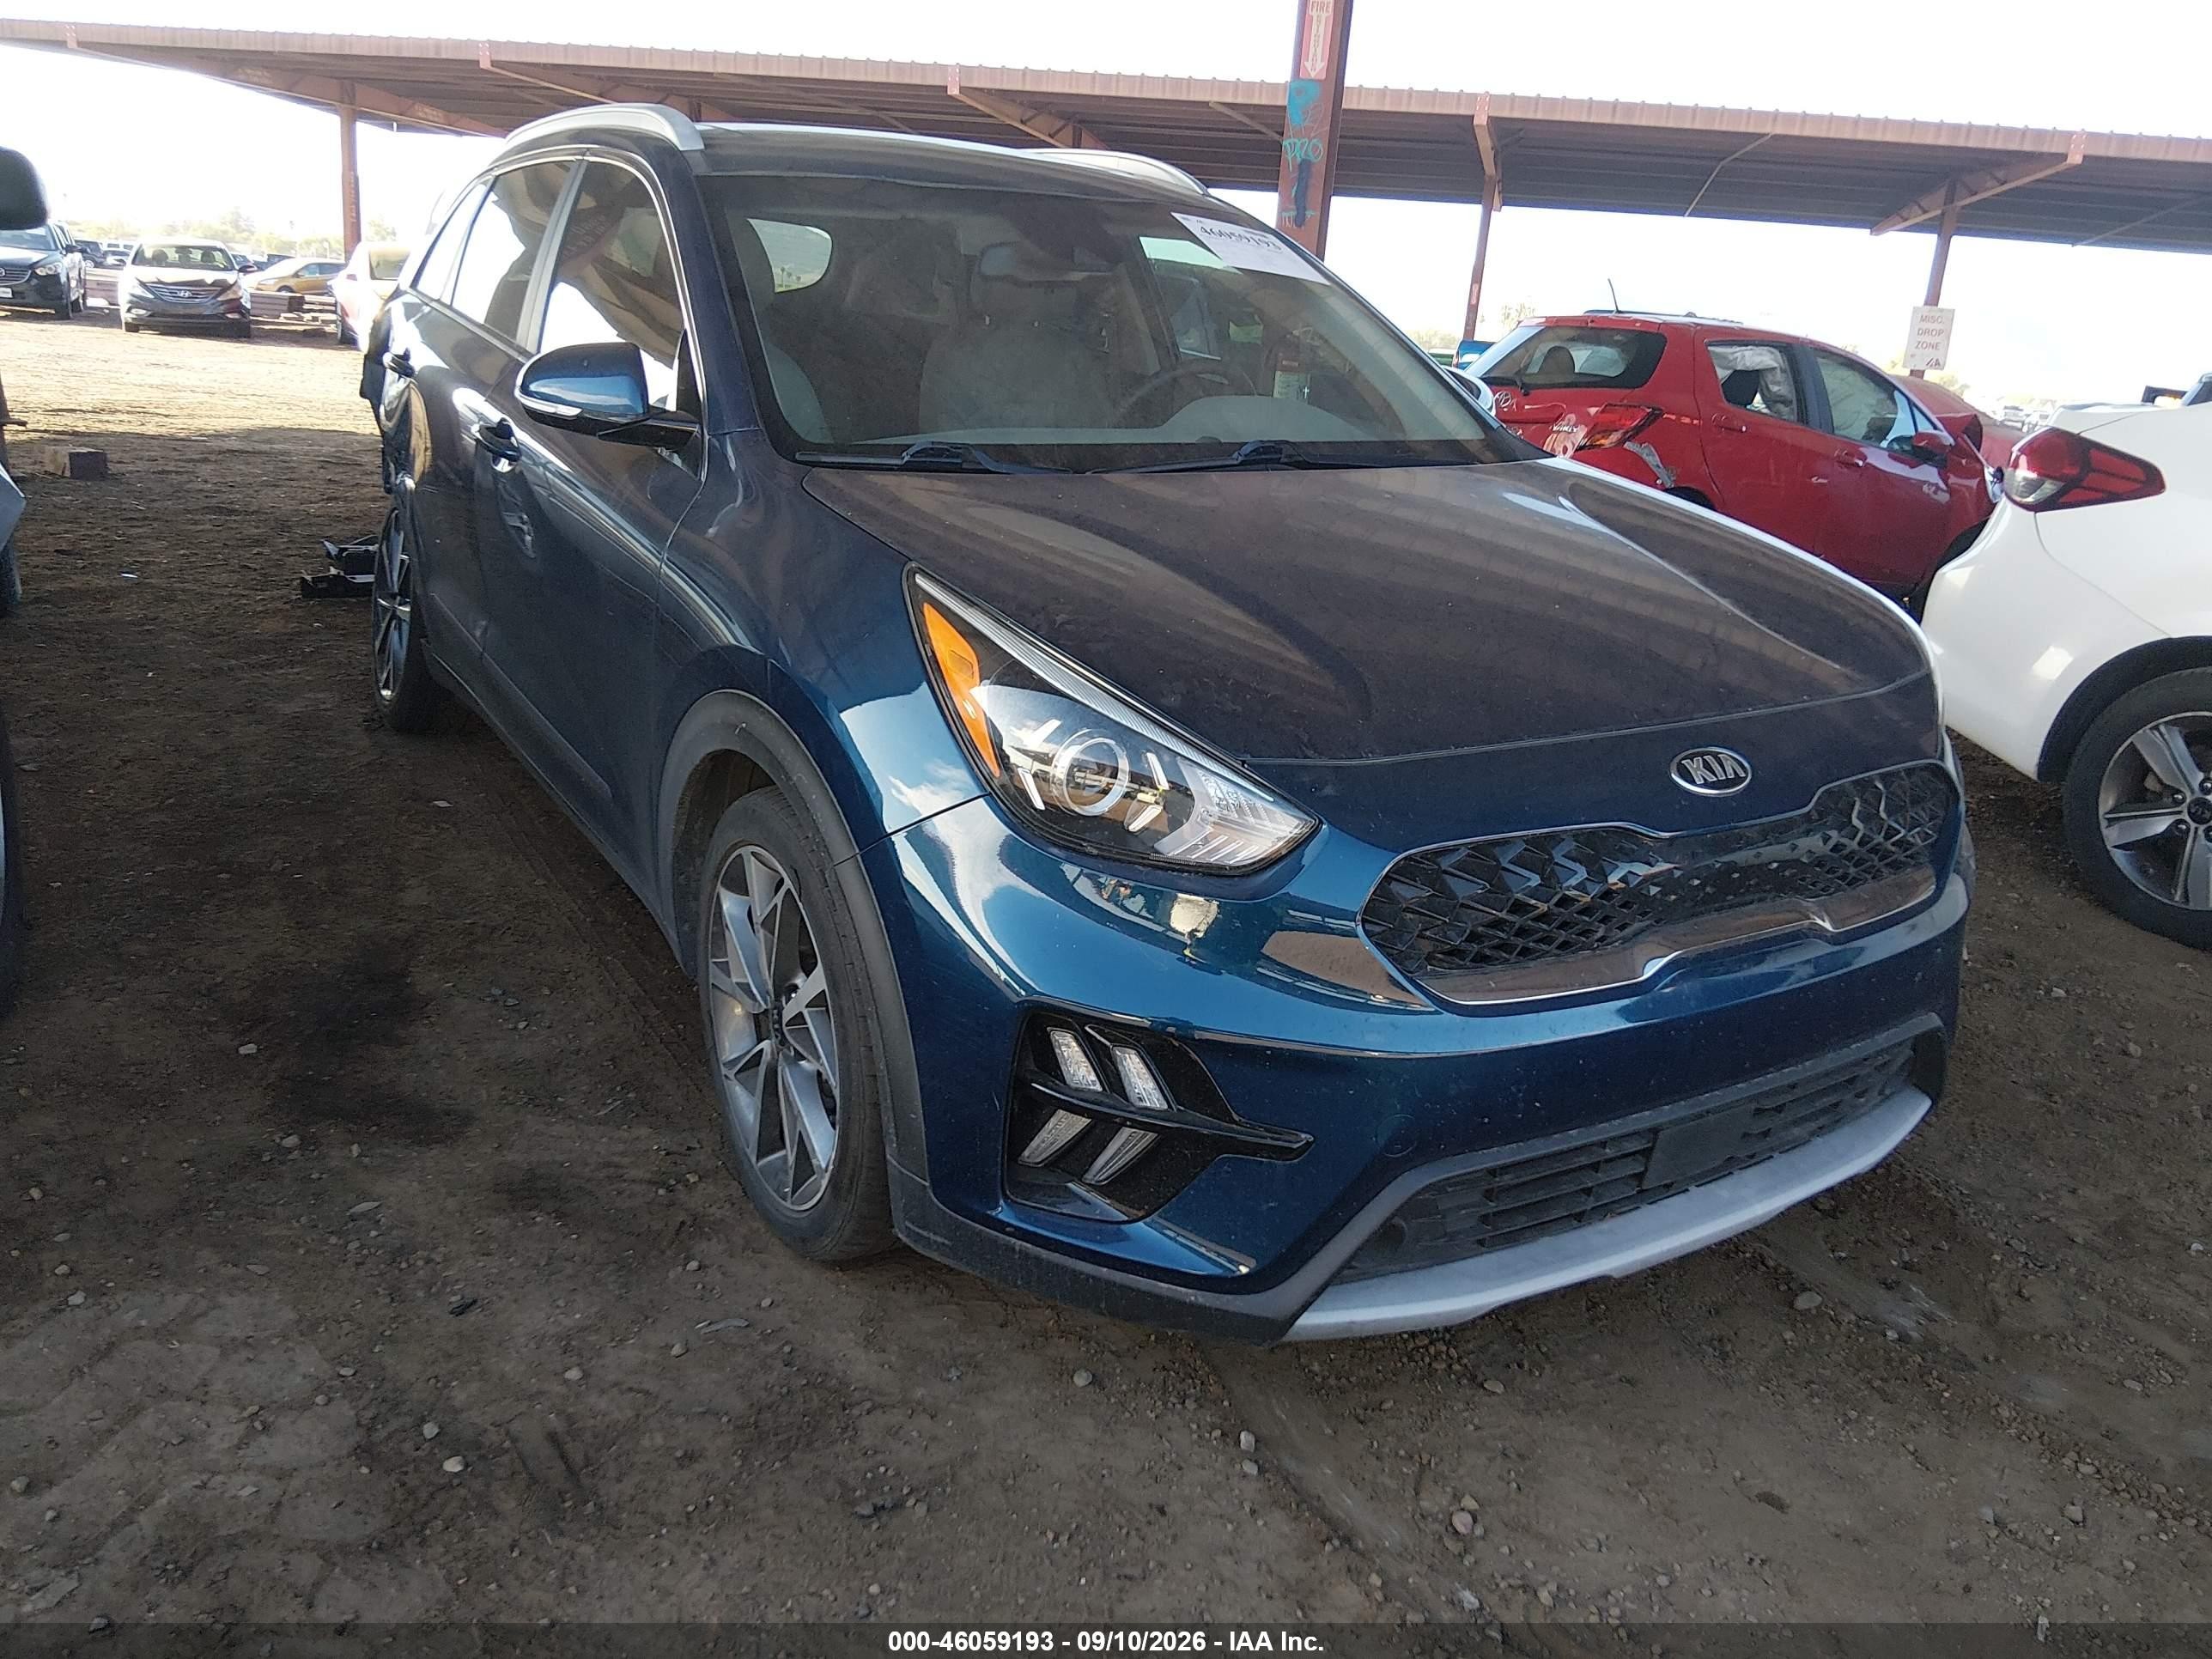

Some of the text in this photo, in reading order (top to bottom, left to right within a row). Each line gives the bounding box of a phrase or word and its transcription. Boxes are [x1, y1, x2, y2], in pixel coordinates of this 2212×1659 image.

[1310, 0, 1332, 14] FIRE
[1919, 314, 1945, 325] MISC.
[1917, 328, 1945, 337] DROP
[1915, 341, 1942, 350] ZONE
[1680, 754, 1747, 785] KIA
